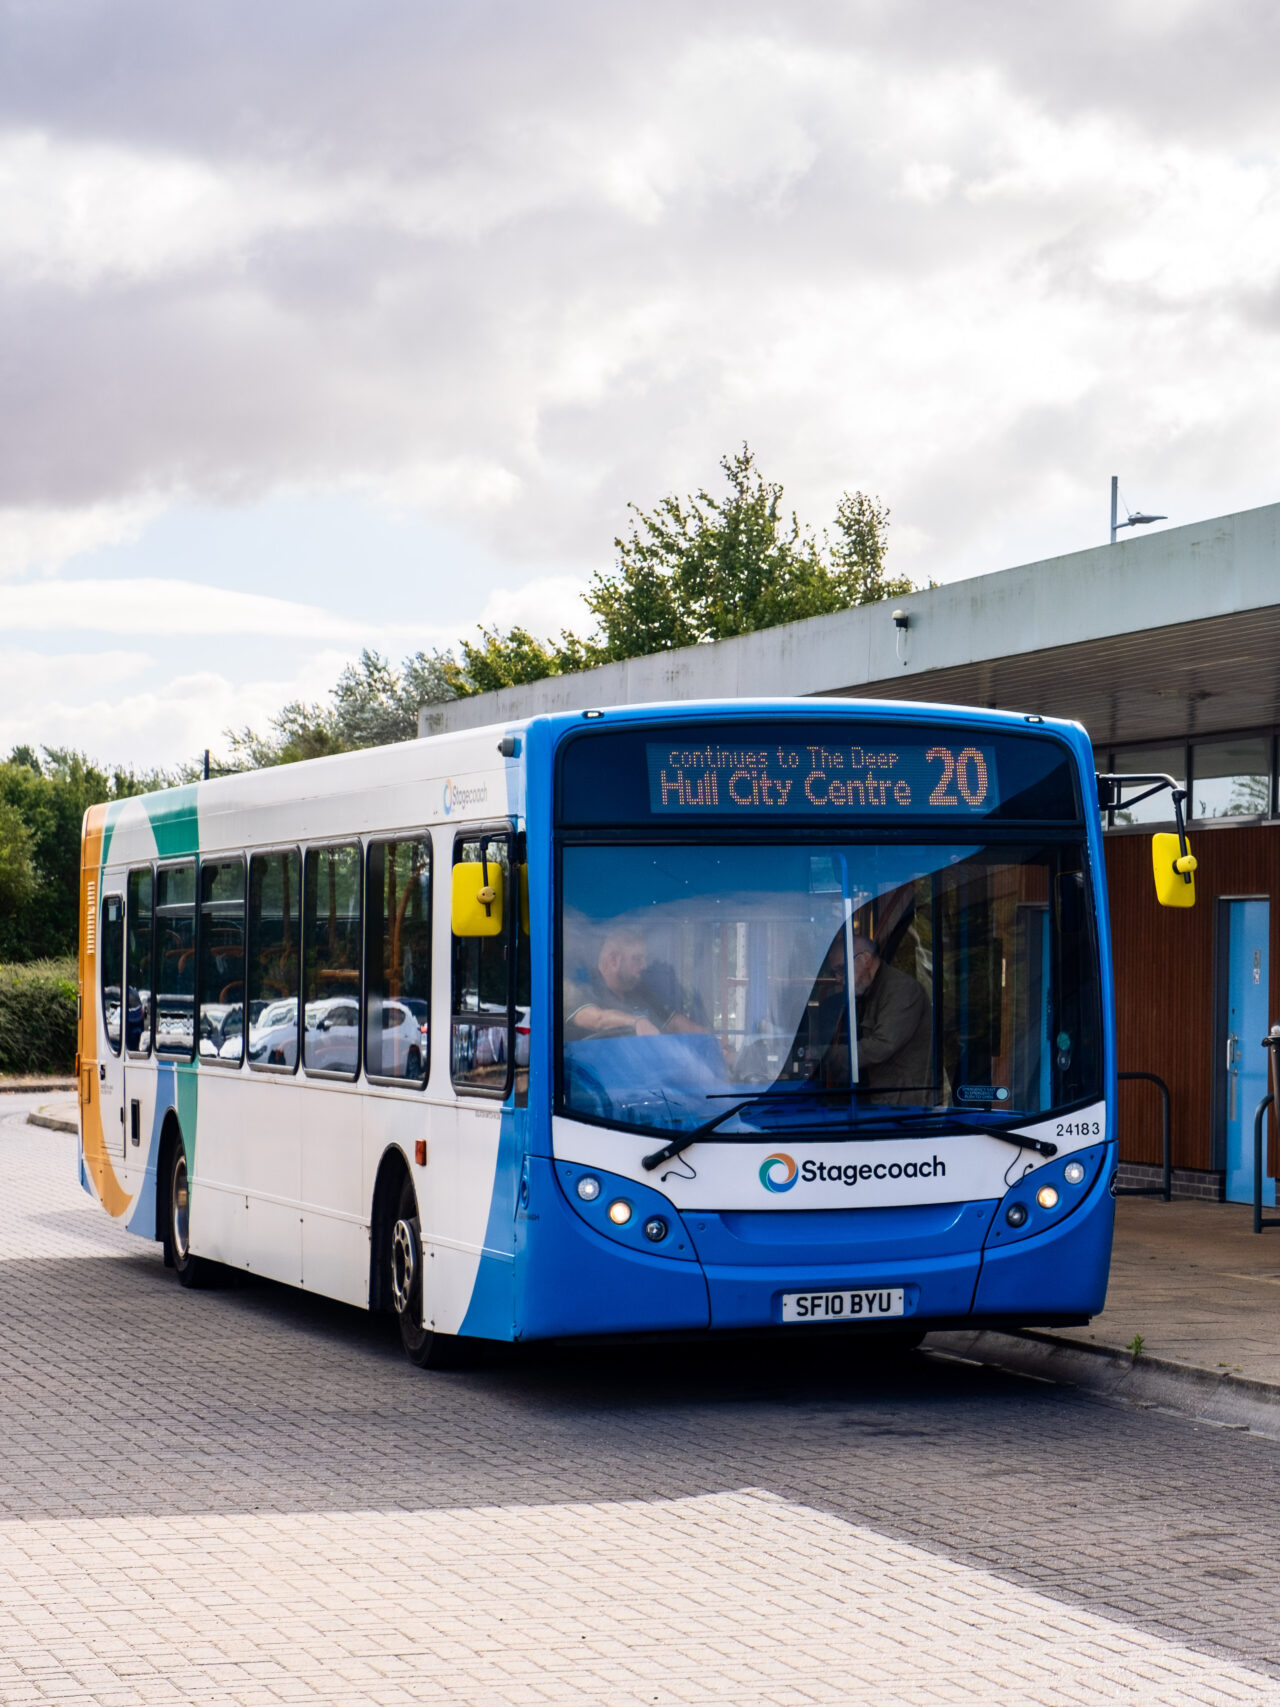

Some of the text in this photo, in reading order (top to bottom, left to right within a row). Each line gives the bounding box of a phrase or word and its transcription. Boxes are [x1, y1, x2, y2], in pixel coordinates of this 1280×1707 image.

[669, 746, 899, 768] continues to The Deep
[661, 770, 911, 805] Hull City Centre
[925, 747, 988, 805] 20
[453, 780, 488, 810] Stagecoach
[1056, 1122, 1100, 1137] 24183
[801, 1155, 946, 1186] Stagecoach
[796, 1292, 891, 1316] SF10 BYU
